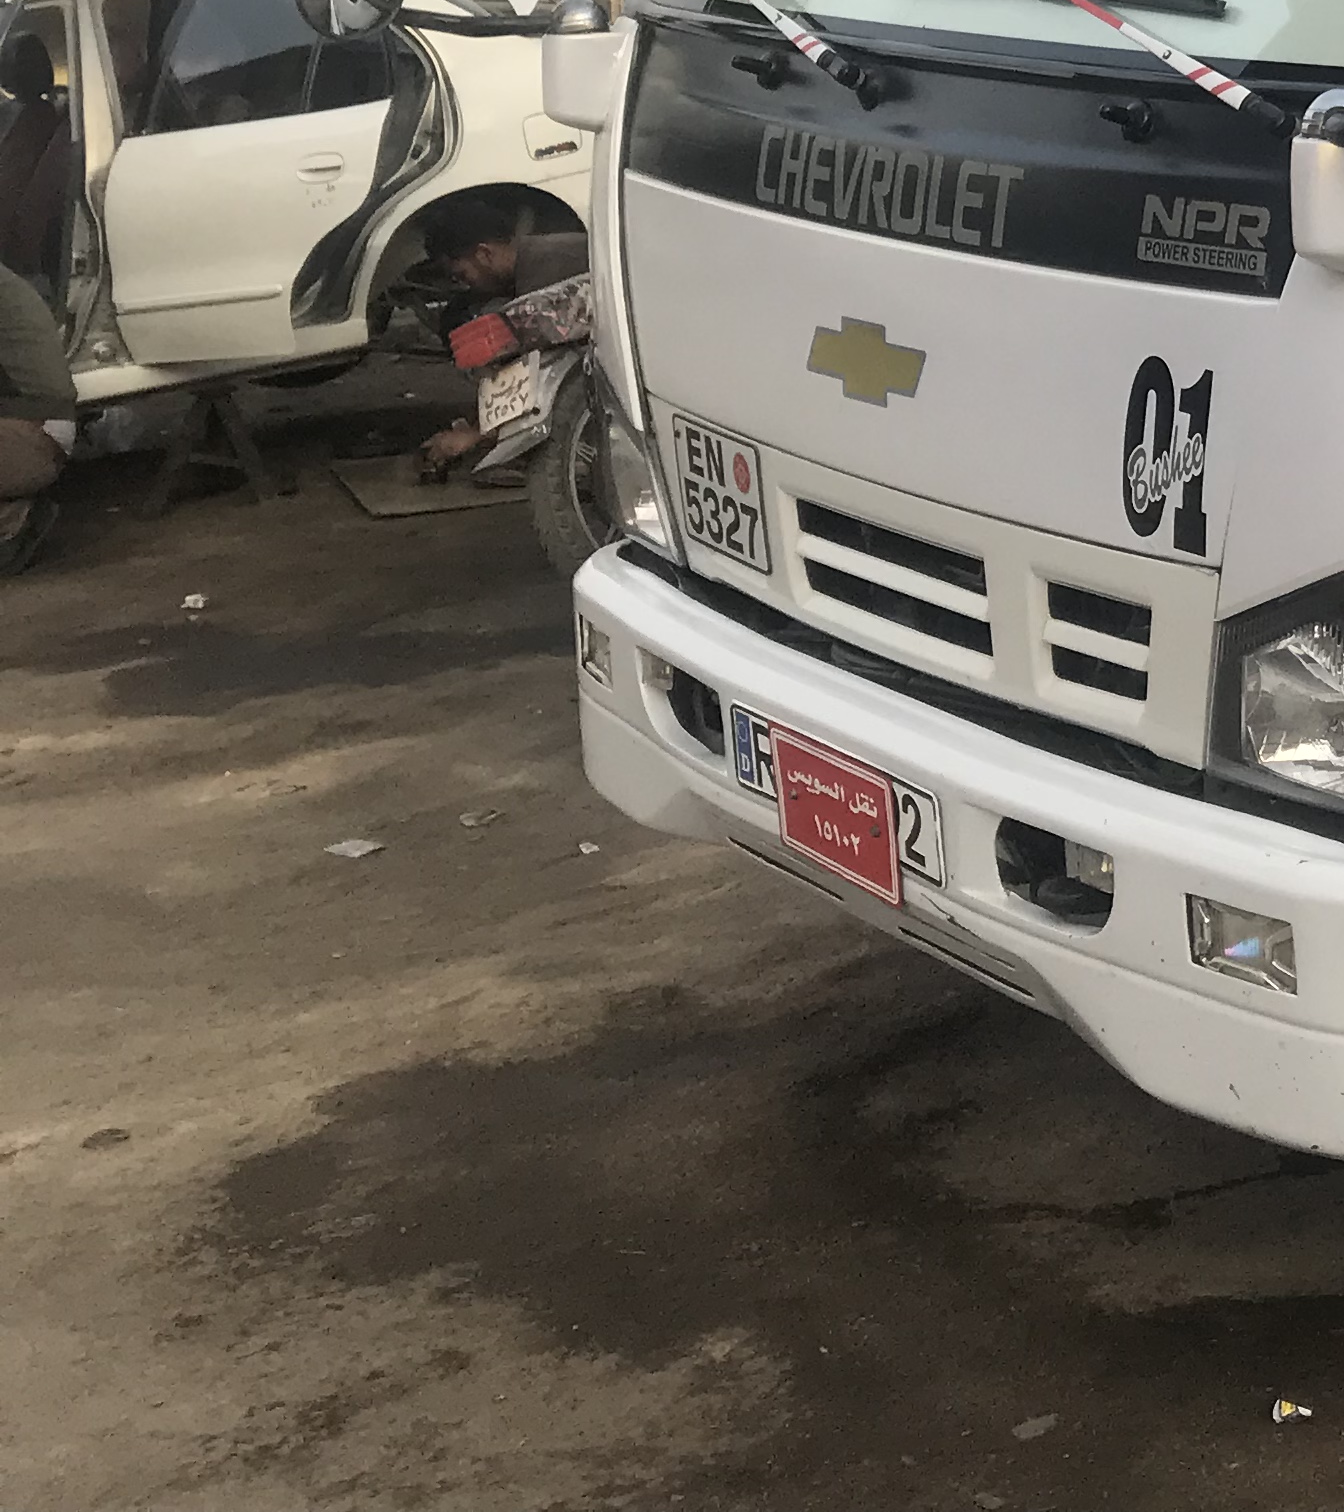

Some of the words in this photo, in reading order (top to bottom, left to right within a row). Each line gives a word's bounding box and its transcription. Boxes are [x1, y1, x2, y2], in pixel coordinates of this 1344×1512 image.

[756, 124, 1025, 248] CHEVROLET
[1141, 194, 1271, 248] NPR
[1144, 240, 1189, 262] POWER
[1192, 247, 1258, 271] STEERING
[685, 426, 726, 487] EN
[684, 477, 758, 560] 5327
[786, 767, 846, 803] السويس
[848, 792, 878, 819] نقل
[893, 786, 927, 868] 2
